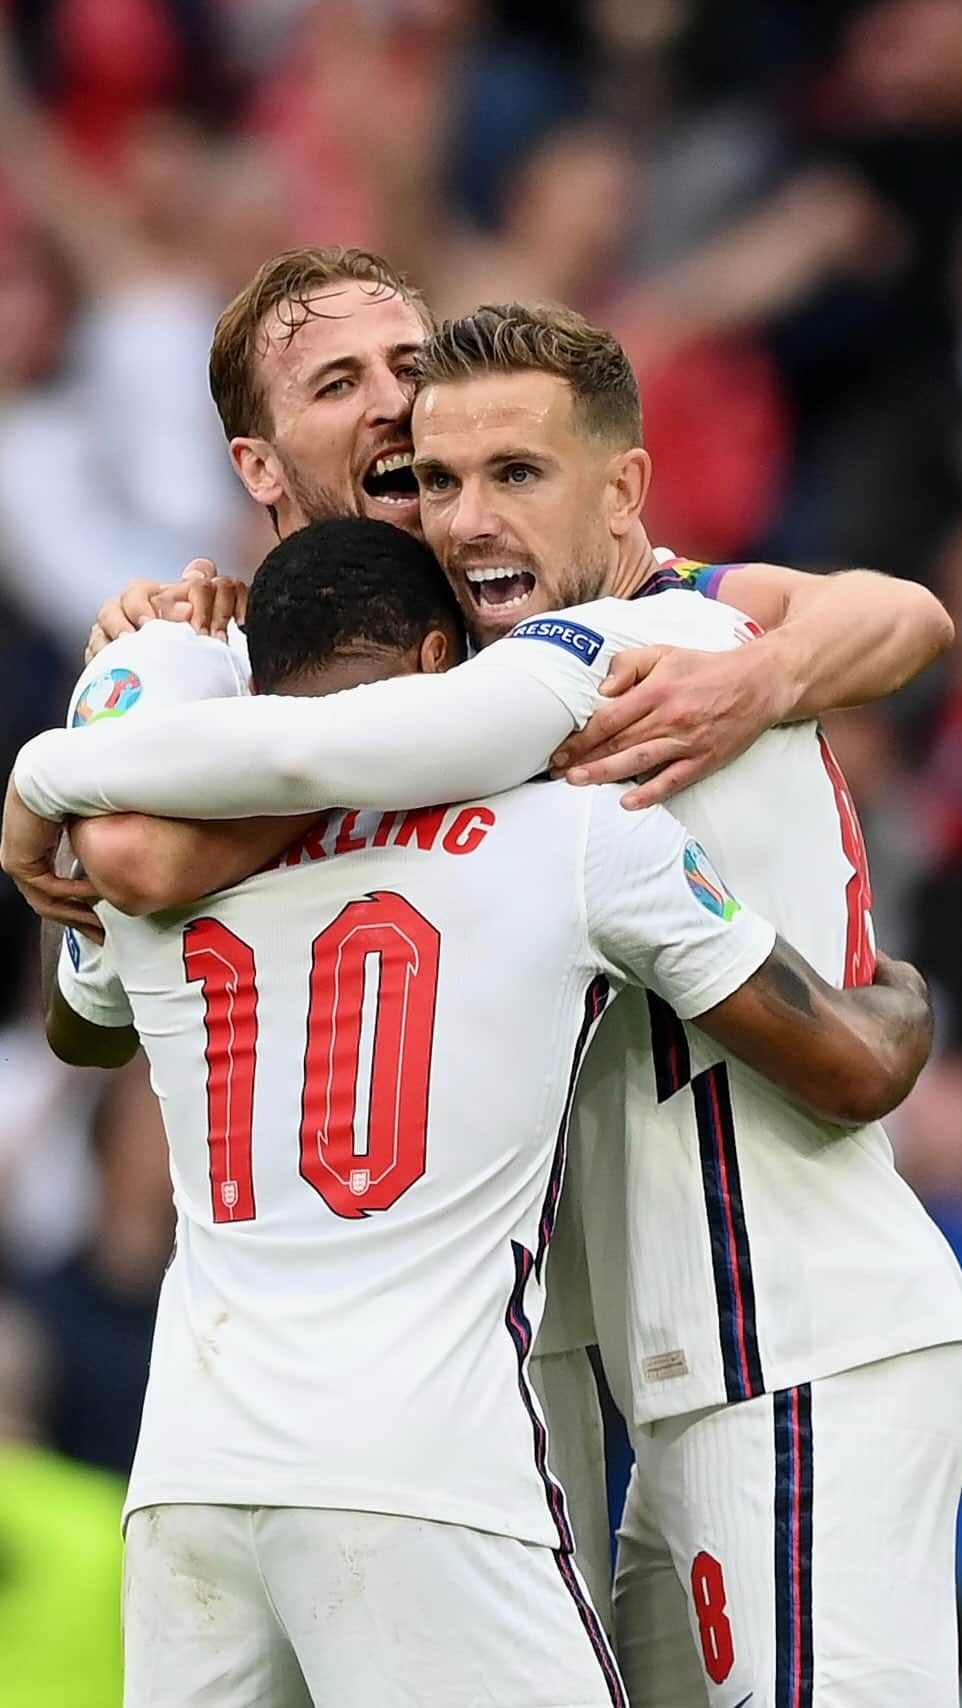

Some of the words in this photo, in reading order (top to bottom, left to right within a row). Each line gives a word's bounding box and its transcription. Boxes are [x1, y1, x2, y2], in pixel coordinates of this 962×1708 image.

[513, 623, 600, 655] RESPECT
[257, 803, 496, 870] RLING
[182, 891, 440, 1222] 10
[691, 1551, 734, 1685] 8
